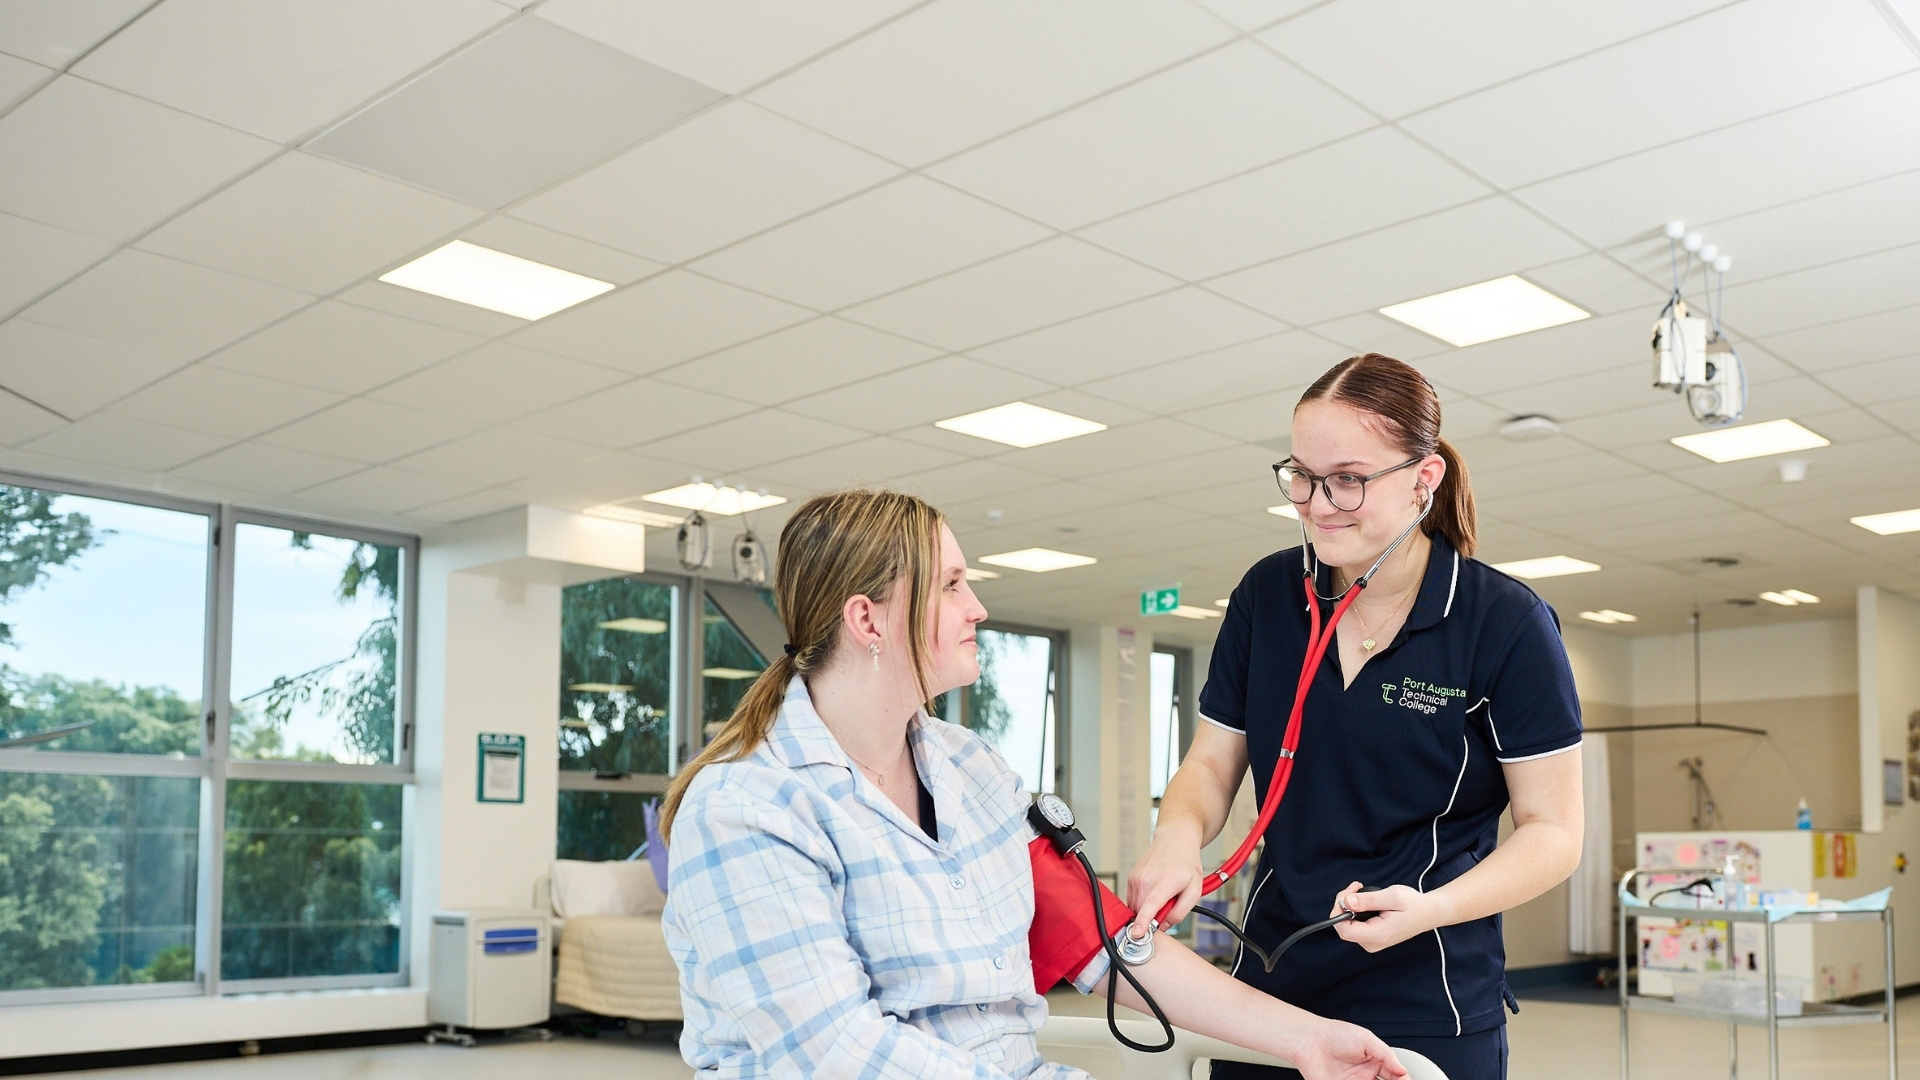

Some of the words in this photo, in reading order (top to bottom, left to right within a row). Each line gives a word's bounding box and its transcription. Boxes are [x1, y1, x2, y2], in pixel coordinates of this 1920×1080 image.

[1401, 687, 1448, 706] Technical
[1402, 676, 1426, 690] Port
[1426, 683, 1467, 698] Augusta
[1398, 697, 1437, 714] College
